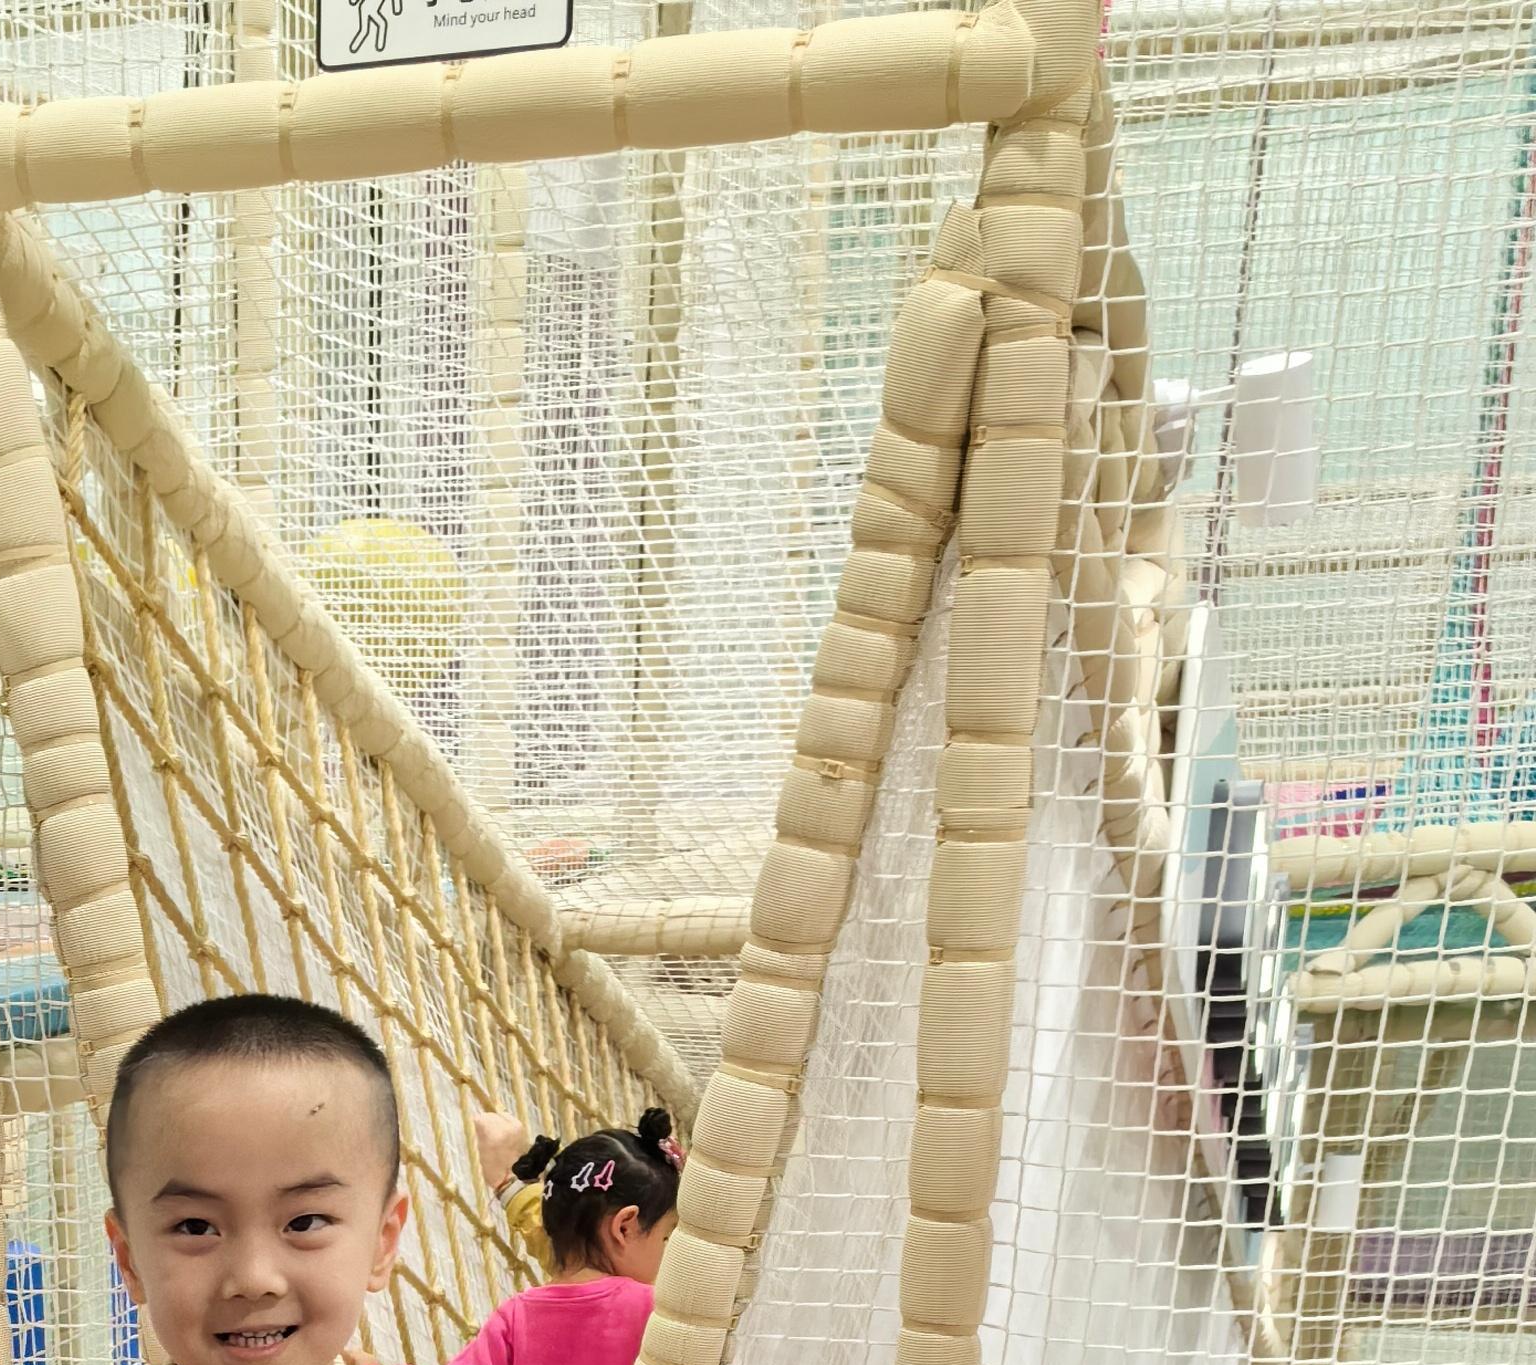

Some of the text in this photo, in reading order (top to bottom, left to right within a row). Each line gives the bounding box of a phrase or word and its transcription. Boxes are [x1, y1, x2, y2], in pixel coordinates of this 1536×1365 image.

[433, 4, 537, 28] Mind your head
